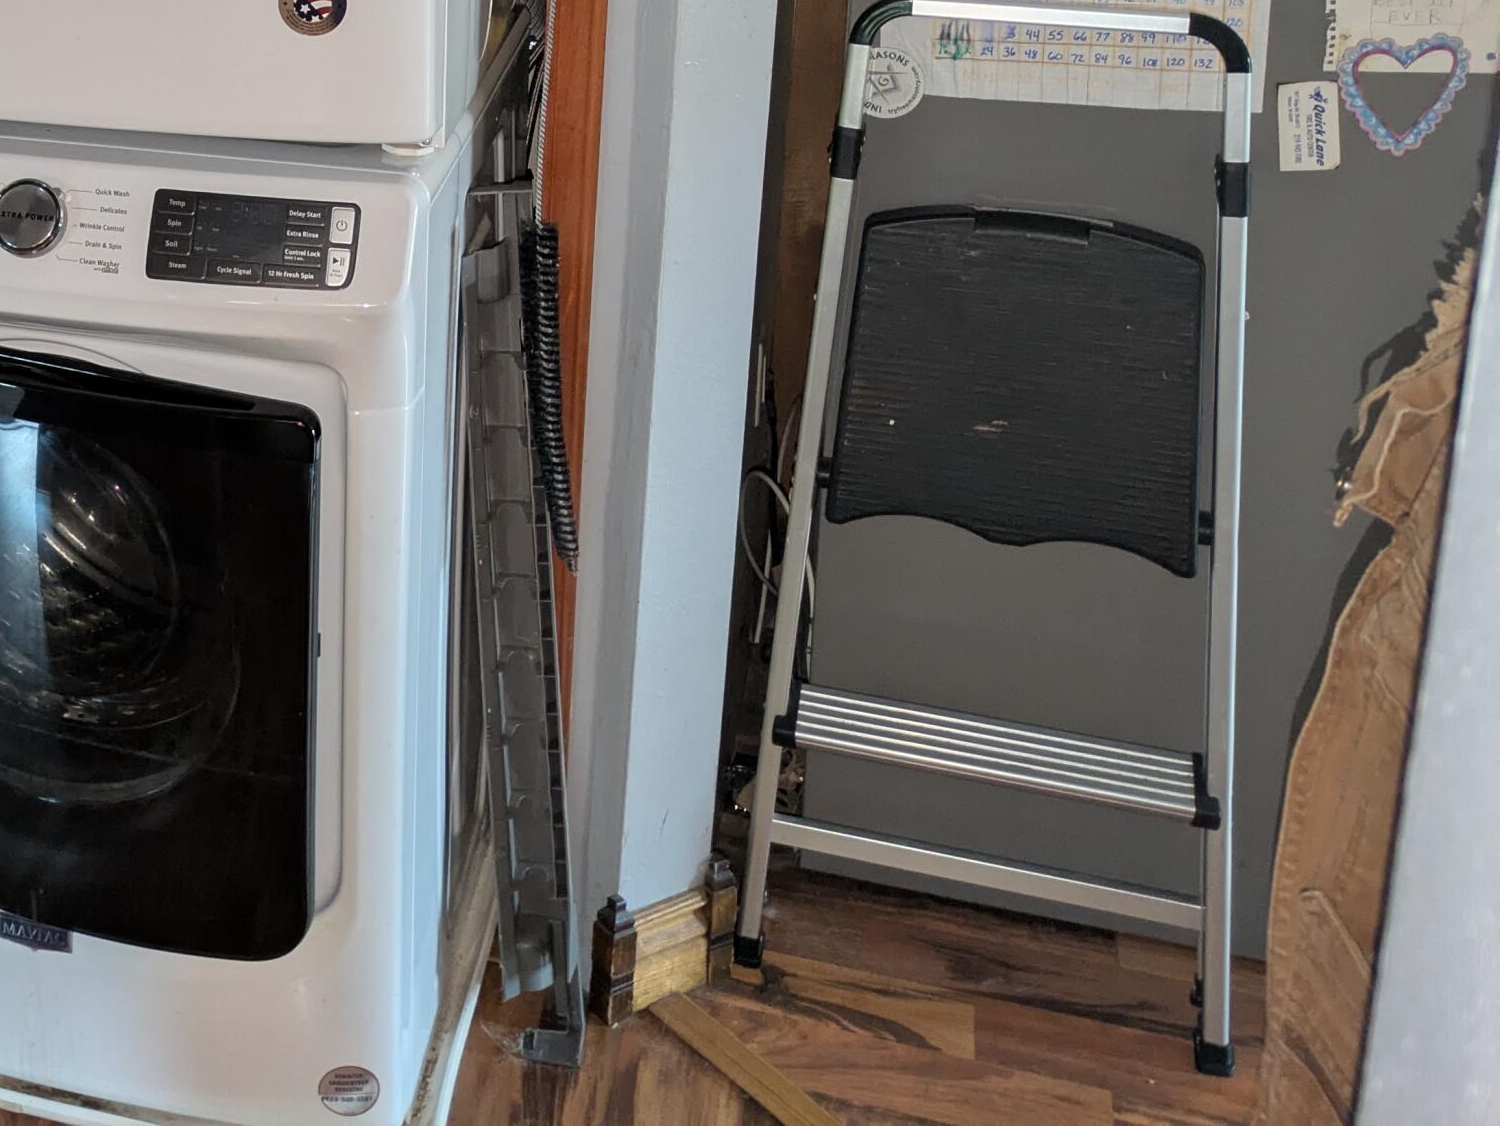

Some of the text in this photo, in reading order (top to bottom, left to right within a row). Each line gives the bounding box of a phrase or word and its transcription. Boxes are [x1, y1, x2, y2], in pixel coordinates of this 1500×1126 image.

[1002, 46, 1213, 69] 36 48 60 72 84 96 120 132
[1313, 104, 1327, 166] Quick Lane
[95, 188, 112, 197] Quick
[169, 198, 186, 207] Temp
[100, 207, 127, 215] Delicates
[289, 210, 321, 218] Delay Start
[25, 212, 55, 222] POWER
[79, 222, 125, 232] Wrinkle Control
[167, 219, 182, 228] Spin
[286, 230, 319, 239] Extra Rinse
[85, 240, 101, 248] Drain
[109, 242, 122, 251] Spin
[165, 239, 178, 247] Soil
[284, 249, 321, 258] Control Lock
[79, 258, 120, 268] Clean Washer
[168, 261, 187, 269] Steam
[217, 265, 252, 275] Cycle Signal
[283, 270, 299, 278] Fresh
[300, 272, 315, 281] Spin
